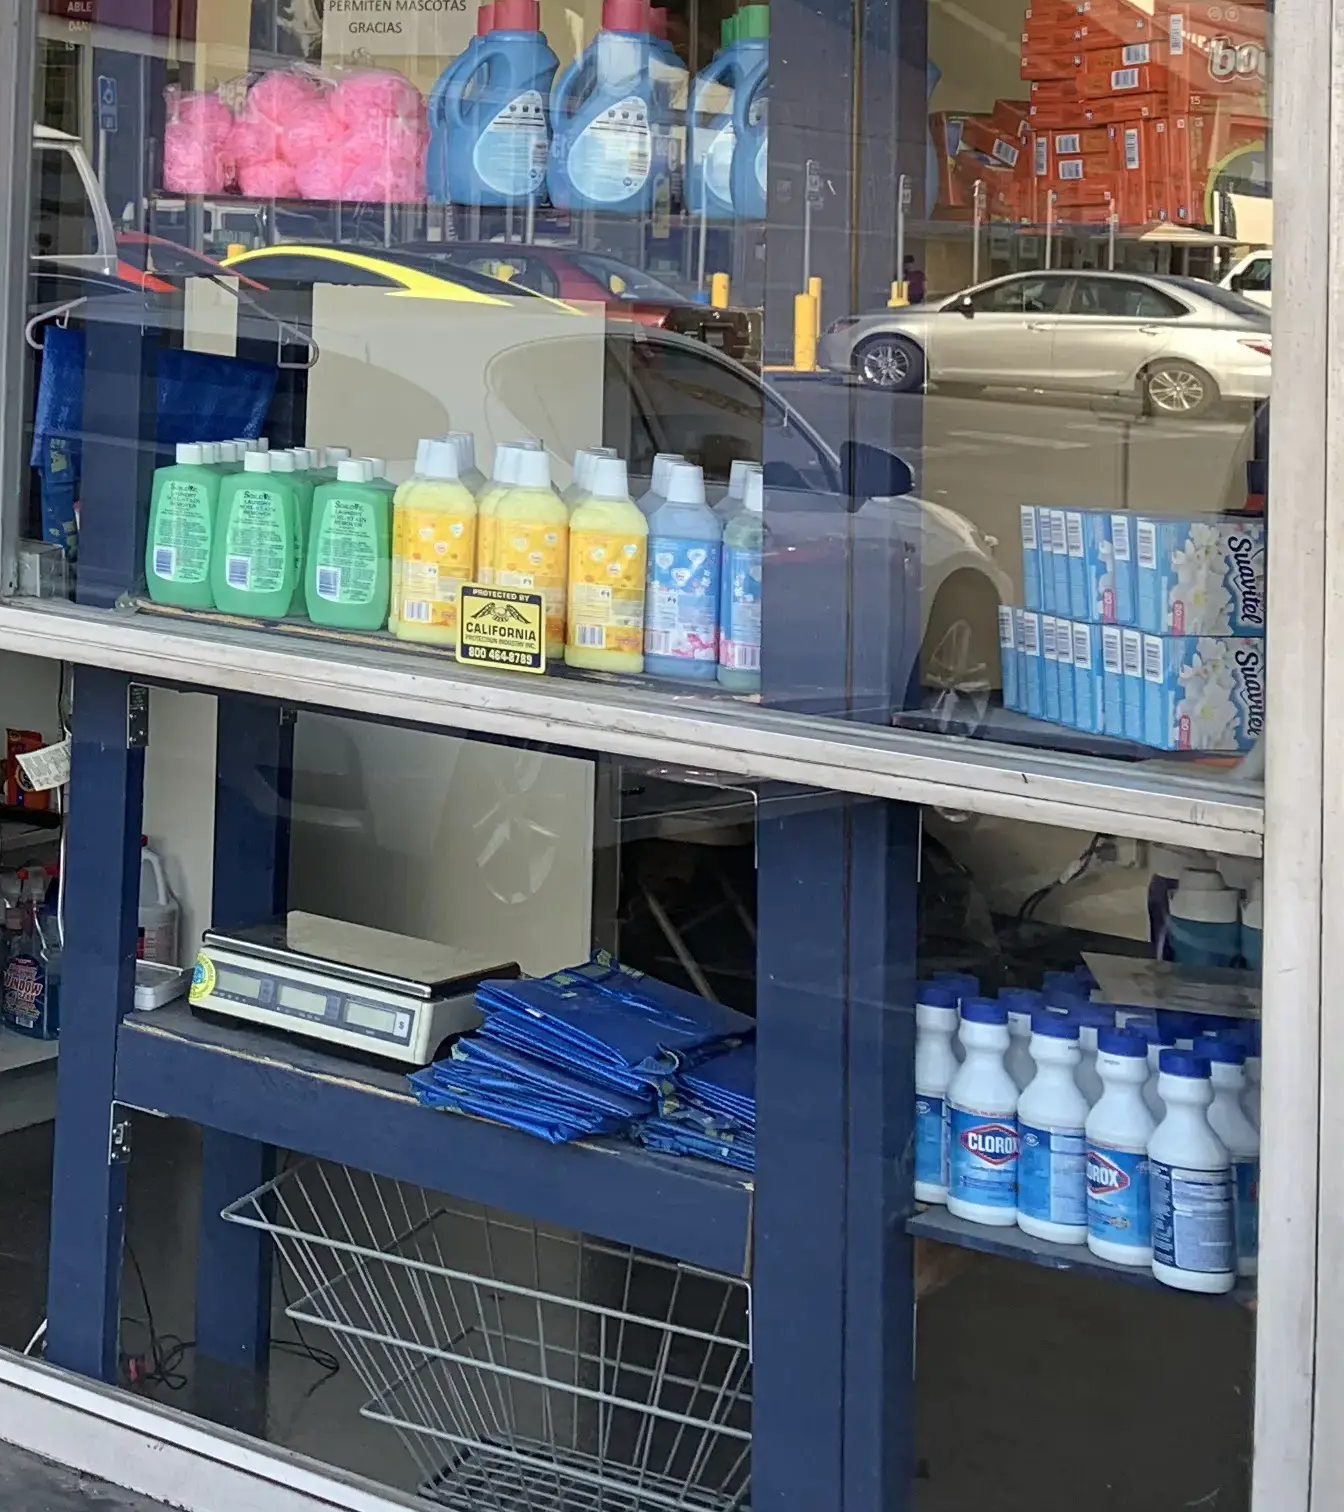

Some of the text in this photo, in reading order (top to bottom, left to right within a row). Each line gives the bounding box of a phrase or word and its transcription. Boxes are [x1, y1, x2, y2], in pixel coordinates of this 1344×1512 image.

[328, 0, 467, 13] PERMITEN MASCOTAS
[348, 20, 403, 35] GRACIAS
[472, 588, 530, 602] PROTECTED BY
[466, 621, 537, 642] CALIFORNIA
[468, 646, 486, 659] 800
